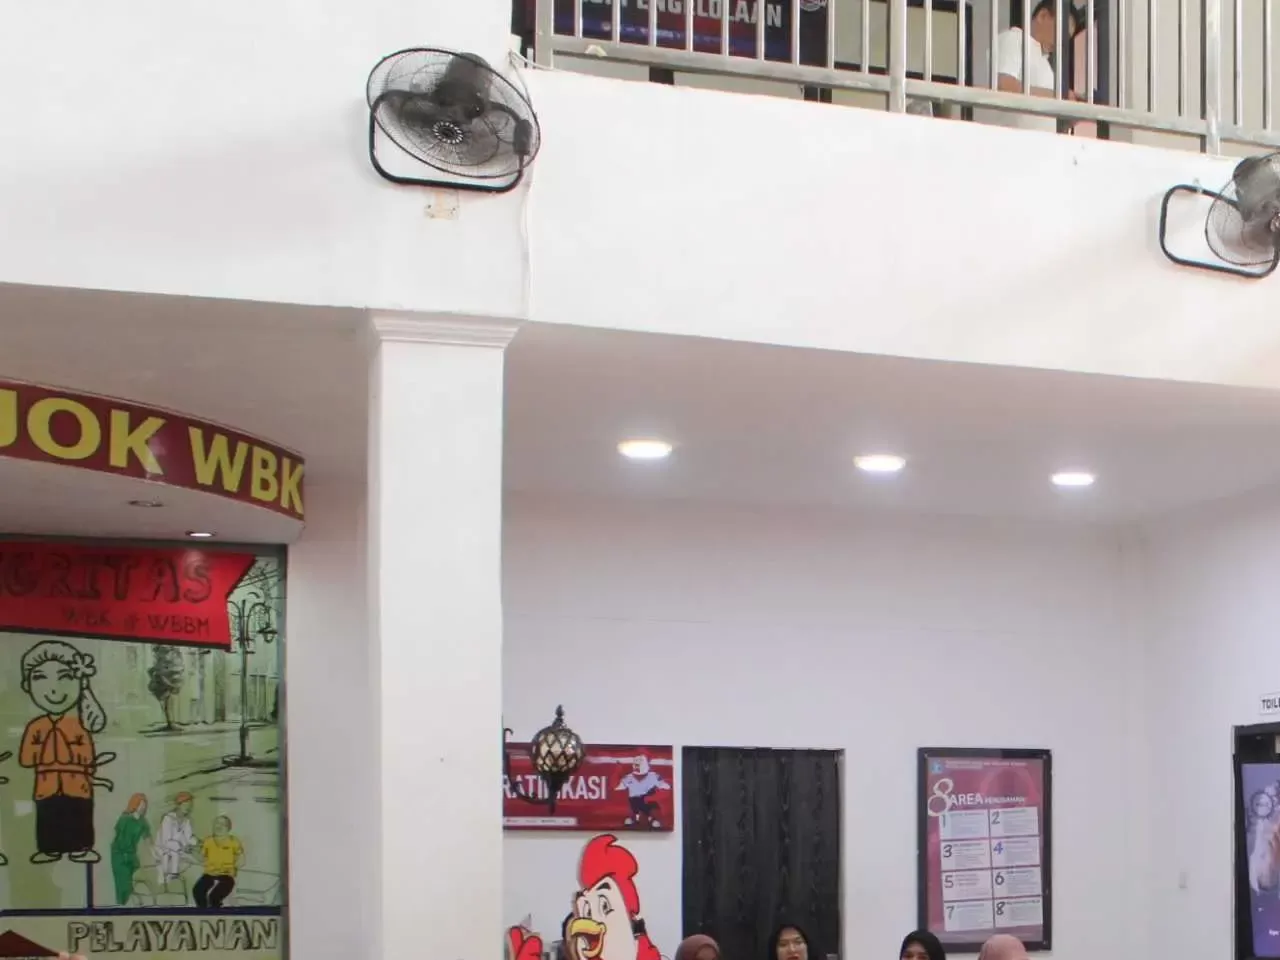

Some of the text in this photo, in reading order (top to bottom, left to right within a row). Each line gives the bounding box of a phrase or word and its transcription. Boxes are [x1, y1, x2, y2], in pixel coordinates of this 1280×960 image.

[188, 425, 304, 514] WBK
[147, 613, 210, 637] WBBM
[501, 774, 607, 800] RATIKASI
[928, 778, 953, 816] 8
[949, 793, 984, 807] AREA
[991, 811, 1000, 825] 2
[943, 844, 952, 858] 3
[993, 841, 1004, 855] 4
[944, 875, 954, 889] 5
[995, 872, 1005, 886] 6
[946, 905, 955, 920] 7
[996, 901, 1006, 916] 8
[68, 918, 278, 951] PELAYANAN
